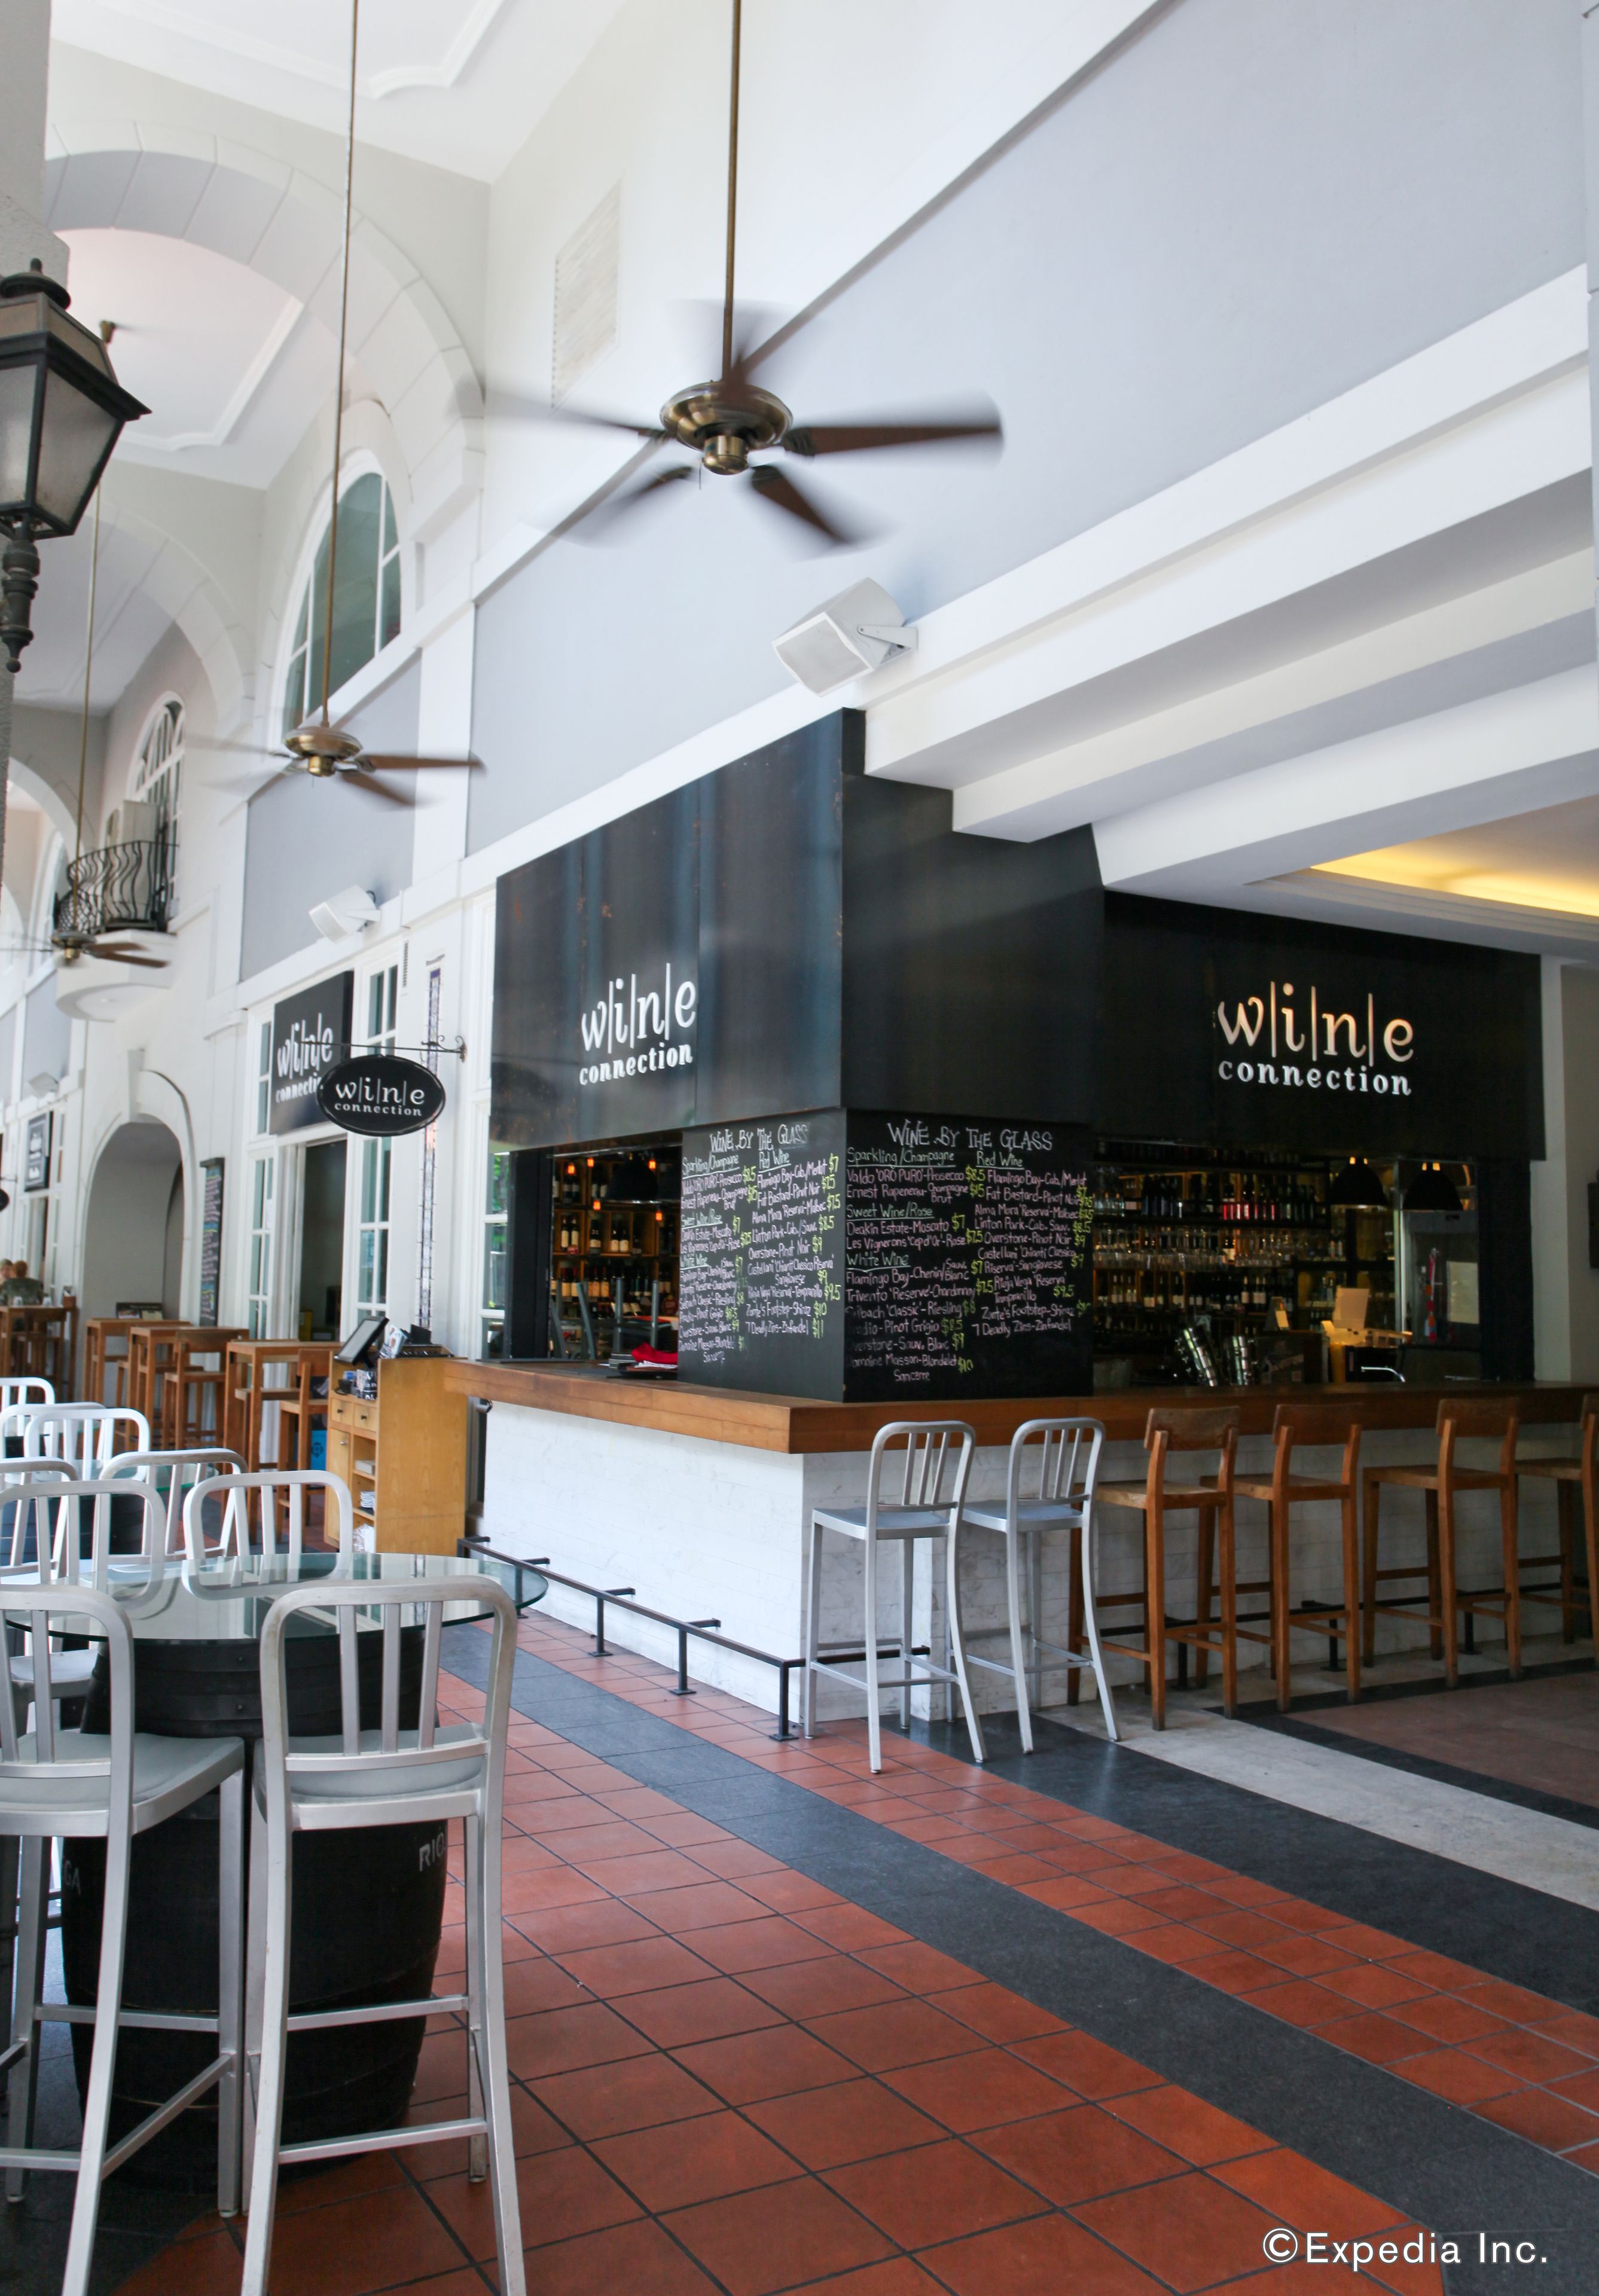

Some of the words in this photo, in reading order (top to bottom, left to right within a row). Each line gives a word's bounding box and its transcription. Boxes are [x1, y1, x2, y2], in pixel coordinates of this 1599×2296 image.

[579, 1042, 693, 1085] connection
[1219, 1061, 1412, 1096] connection
[275, 1072, 322, 1103] connecti
[334, 1103, 422, 1117] connection
[777, 1124, 808, 1144] GLASS
[887, 1119, 930, 1147] WINE
[933, 1126, 960, 1147] BY
[966, 1127, 992, 1150] THE
[1000, 1129, 1052, 1152] GLASS
[828, 1153, 839, 1173] $7
[977, 1150, 996, 1165] Red
[999, 1152, 1023, 1167] Wine
[847, 1168, 875, 1184] Valdo
[987, 1170, 1024, 1187] Flamingo
[847, 1184, 878, 1199] Ernest
[970, 1182, 985, 1198] $15
[986, 1186, 1001, 1201] Fat
[846, 1202, 877, 1218] Sweet
[975, 1204, 996, 1216] Alma
[951, 1213, 965, 1231] $7
[975, 1217, 1002, 1229] Linton
[846, 1237, 862, 1250] Les
[864, 1238, 907, 1253] Vignerons
[1055, 1232, 1072, 1244] Noir
[846, 1251, 879, 1266] White
[882, 1251, 908, 1266] Wine
[847, 1271, 889, 1289] Flamingo
[971, 1260, 983, 1275] $7
[846, 1289, 887, 1302] Trivento
[813, 1300, 827, 1318] $10
[911, 1318, 939, 1335] Grigio
[971, 1324, 979, 1336] 7
[982, 1321, 1011, 1338] Deadly
[419, 1832, 446, 1871] RIO
